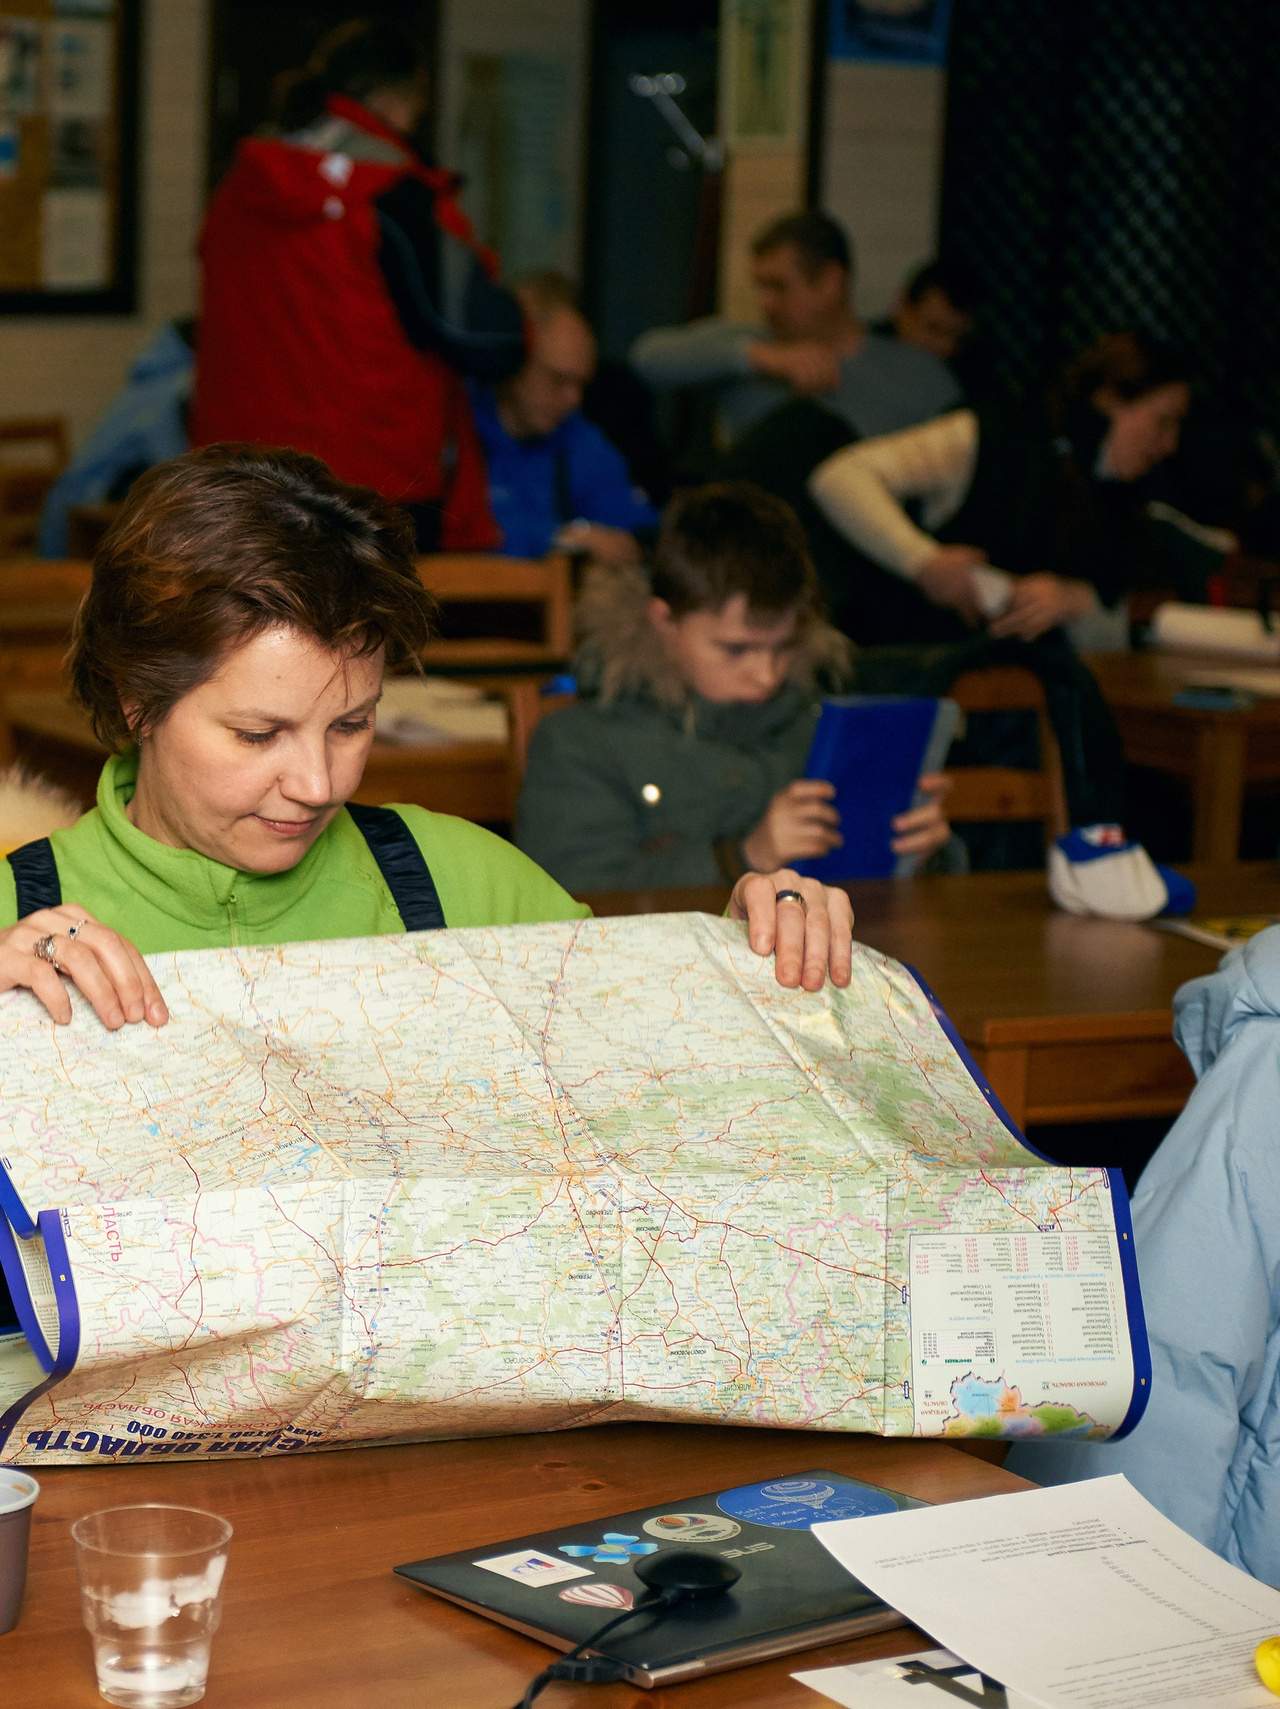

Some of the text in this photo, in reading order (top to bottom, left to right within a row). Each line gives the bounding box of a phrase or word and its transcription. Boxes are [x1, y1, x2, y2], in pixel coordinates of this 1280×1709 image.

[102, 1205, 122, 1262] ЛАСТЬ
[126, 1420, 168, 1439] 000
[26, 1430, 201, 1456] ОБЛАСТЬ
